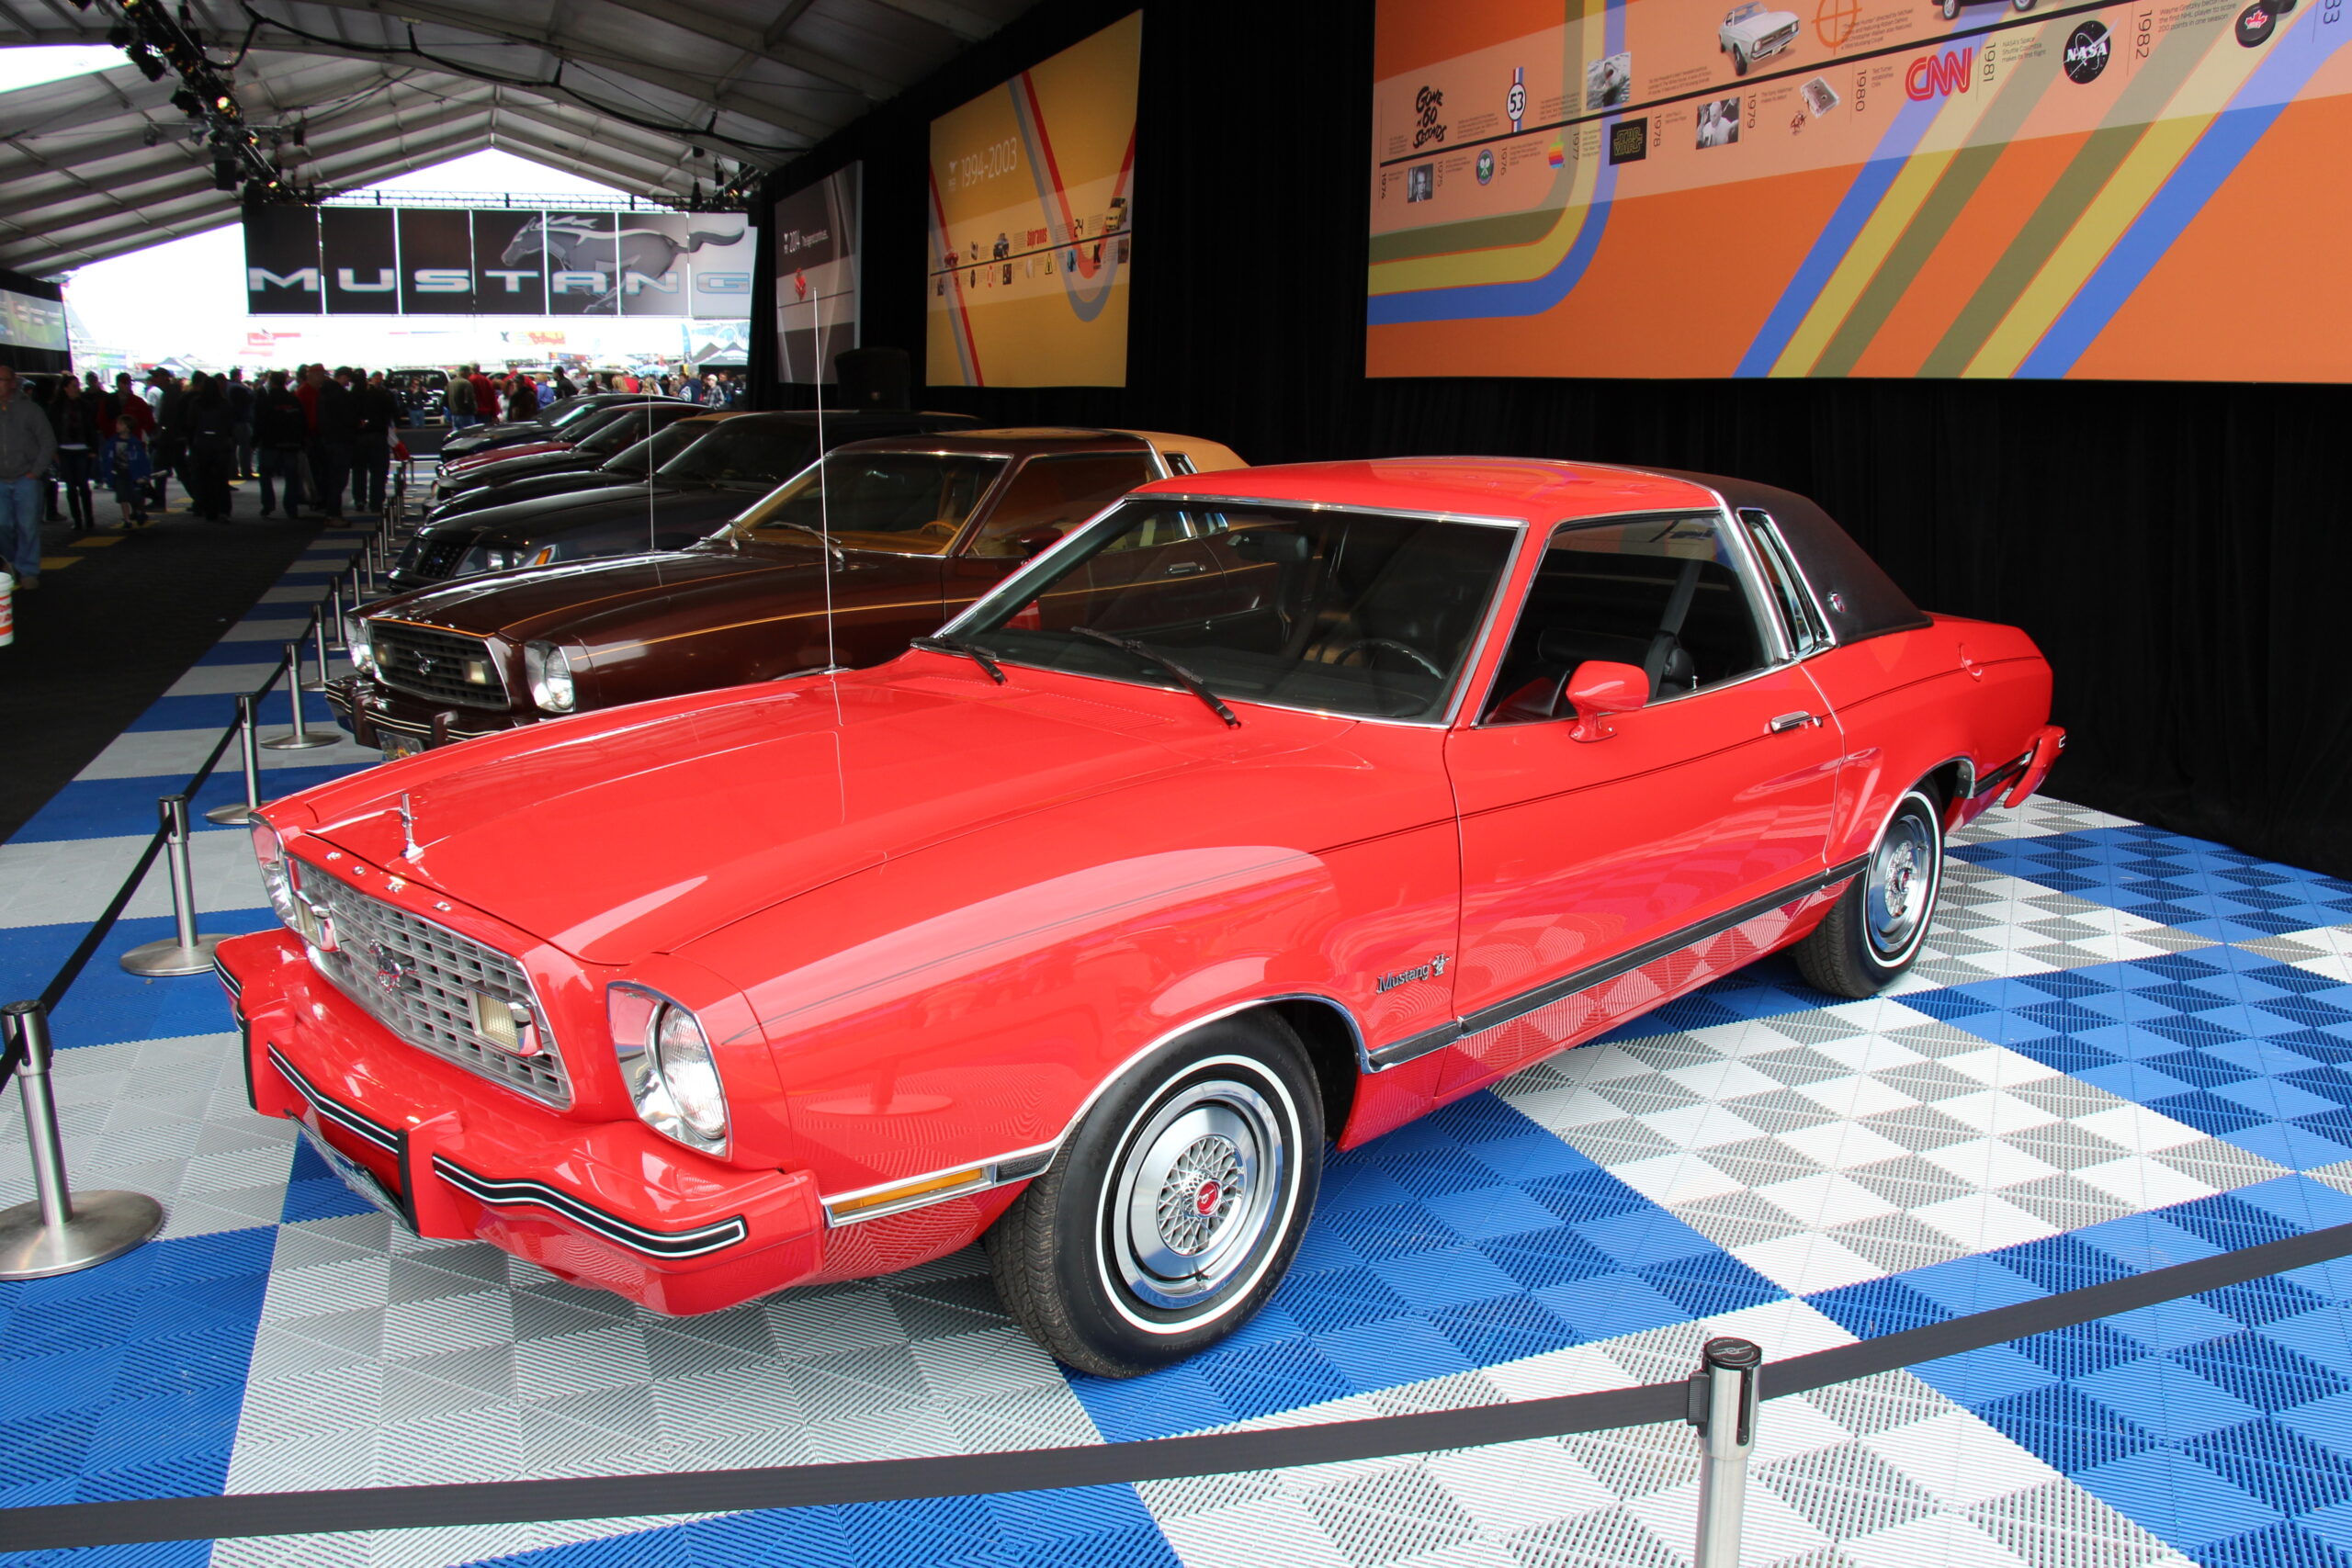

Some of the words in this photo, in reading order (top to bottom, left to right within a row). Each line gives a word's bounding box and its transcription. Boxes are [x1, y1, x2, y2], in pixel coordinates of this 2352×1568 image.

[2135, 9, 2153, 60] 1982
[1983, 42, 1996, 82] 1981
[2065, 41, 2109, 63] NASA
[1855, 69, 1867, 112] 1980
[1905, 47, 1973, 101] CNN
[1422, 107, 1437, 128] 60
[1510, 91, 1523, 113] 53
[1747, 93, 1757, 129] 1979
[1572, 132, 1580, 161] 1977
[1654, 114, 1662, 148] 1978
[961, 137, 1017, 187] 1994-2003
[248, 267, 751, 294] MUSTANG
[1376, 964, 1430, 994] Mustang
